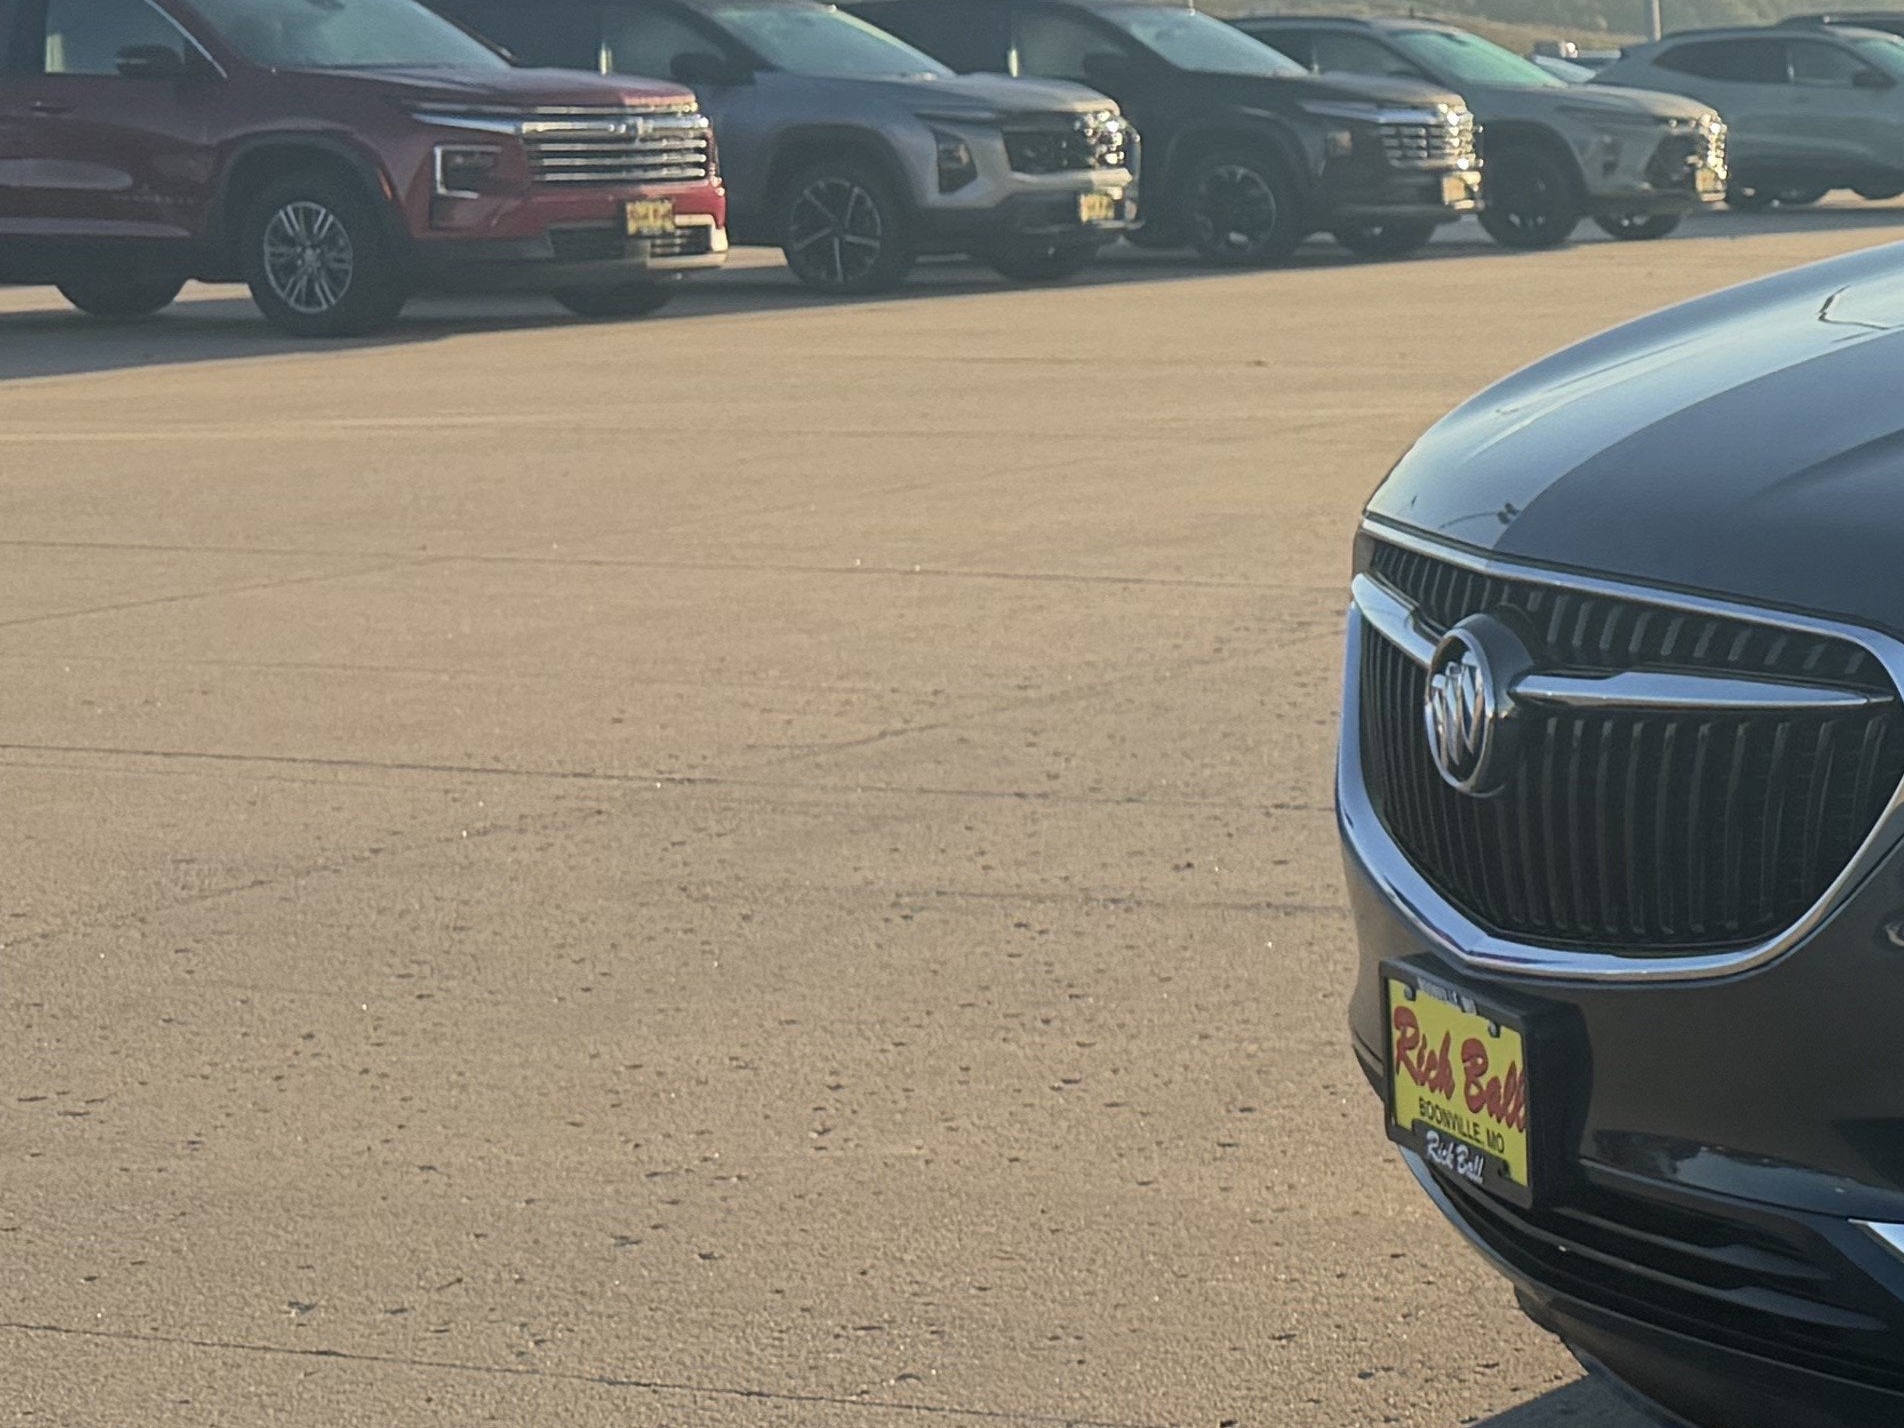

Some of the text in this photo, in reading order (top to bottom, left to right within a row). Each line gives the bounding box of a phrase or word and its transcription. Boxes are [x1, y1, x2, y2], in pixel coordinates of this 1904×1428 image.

[1394, 1006, 1526, 1133] Rick Ball
[1486, 1127, 1505, 1154] MO
